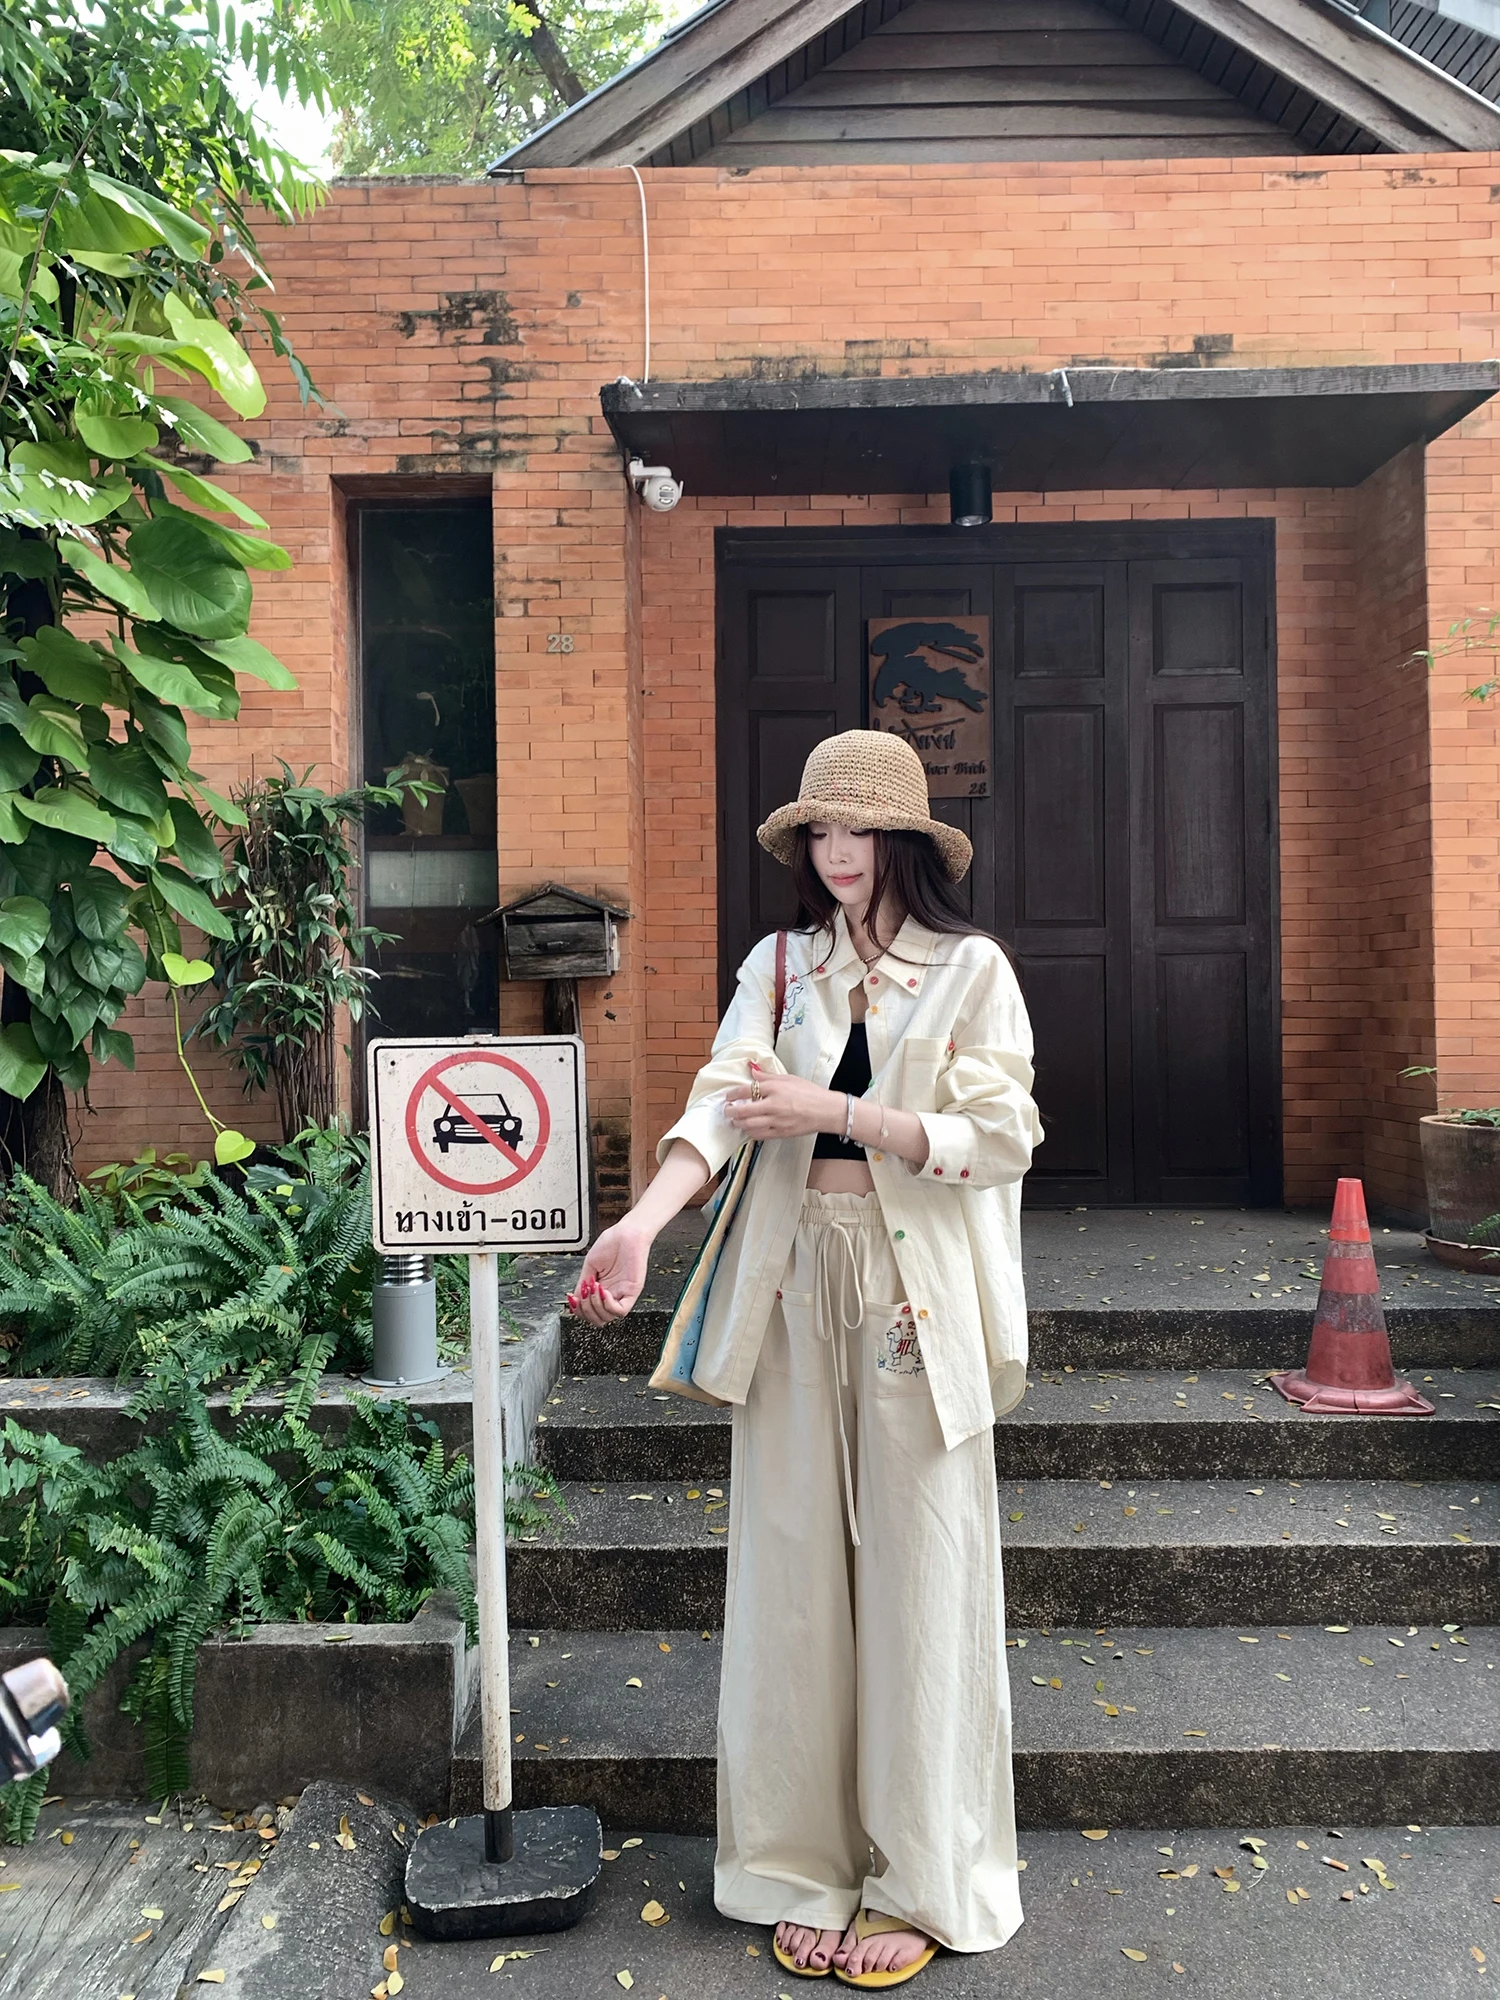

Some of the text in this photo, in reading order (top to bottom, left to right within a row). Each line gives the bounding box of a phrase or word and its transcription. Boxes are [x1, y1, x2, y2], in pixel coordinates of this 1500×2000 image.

[547, 634, 574, 653] 28
[923, 760, 987, 775] lver Birch
[968, 782, 987, 795] 28
[395, 1200, 566, 1233] ทางเข้า-ออก
